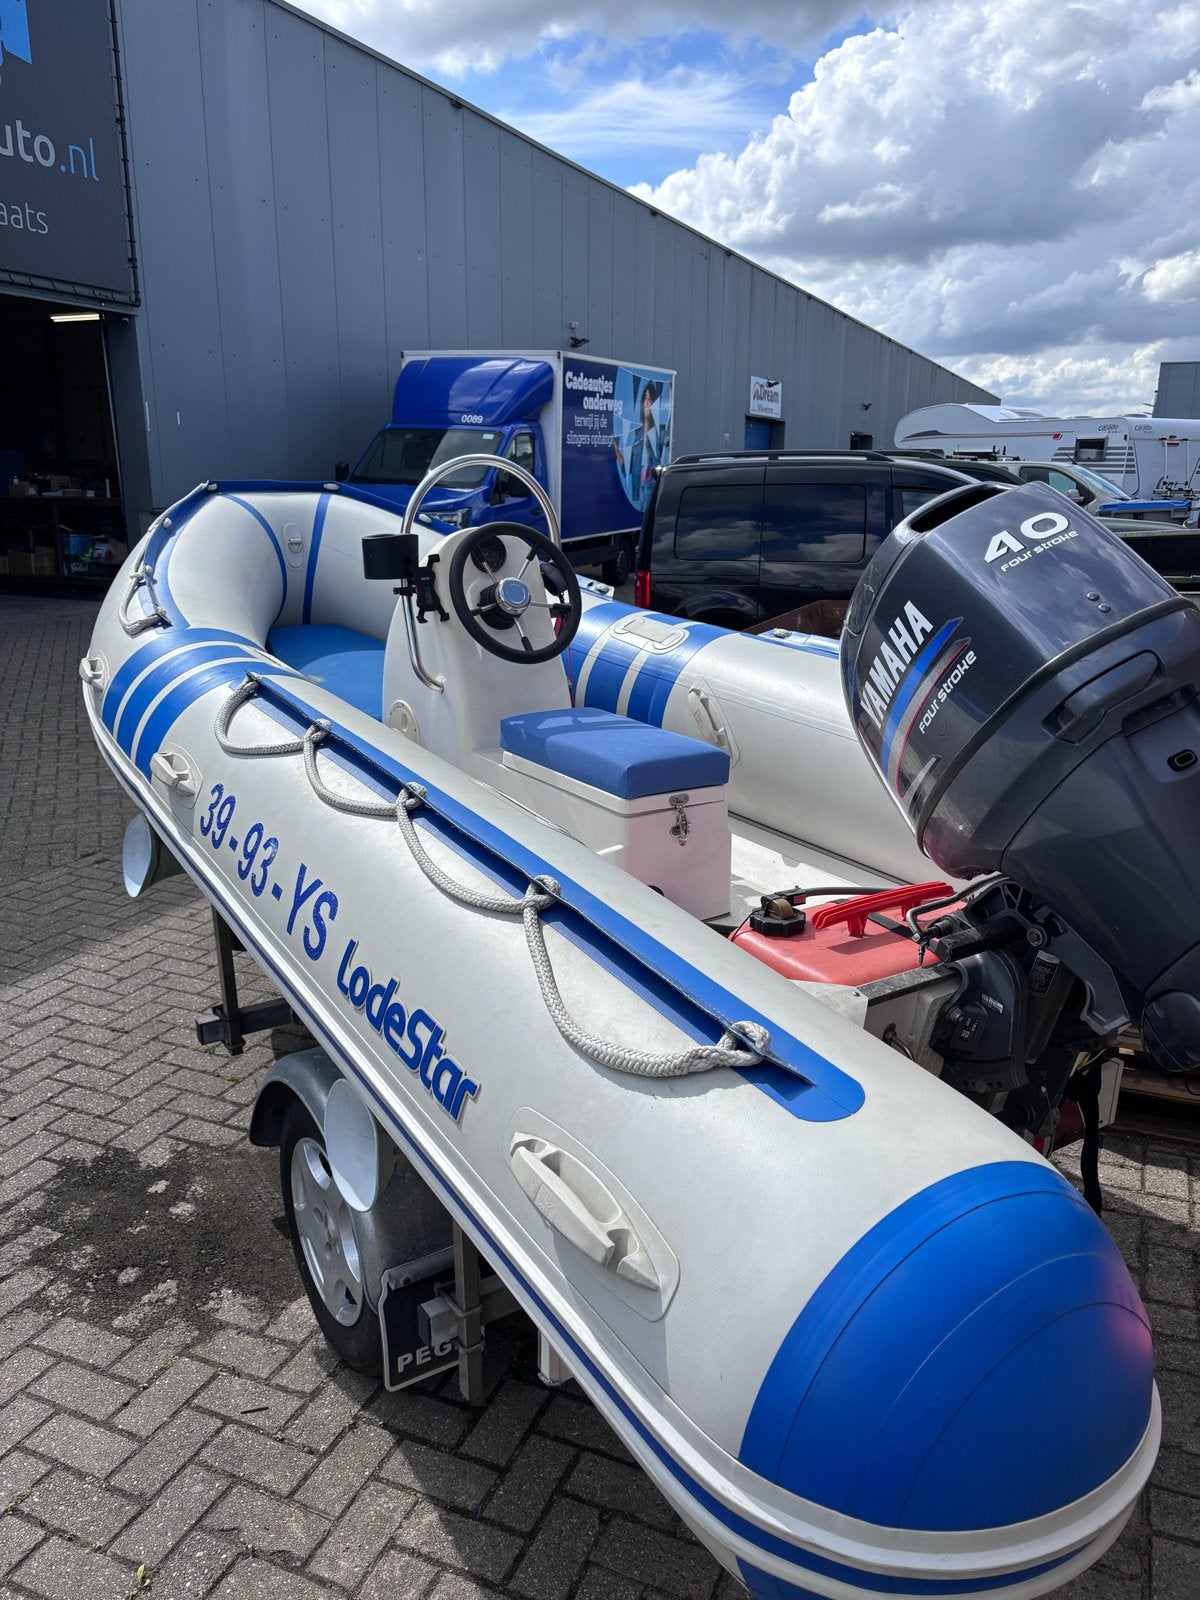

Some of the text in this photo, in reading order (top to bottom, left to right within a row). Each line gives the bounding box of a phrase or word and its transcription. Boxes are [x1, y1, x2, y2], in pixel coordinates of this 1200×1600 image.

[565, 371, 614, 396] Cadeautjes
[461, 414, 483, 424] 0089
[583, 393, 624, 415] onderweg
[574, 414, 594, 430] terwijl
[600, 414, 608, 428] de
[984, 512, 1069, 563] 40
[860, 600, 934, 730] YAMAHA
[200, 783, 339, 962] 39-93-YS
[336, 937, 481, 1121] LodeStar
[397, 1342, 452, 1373] PEG
